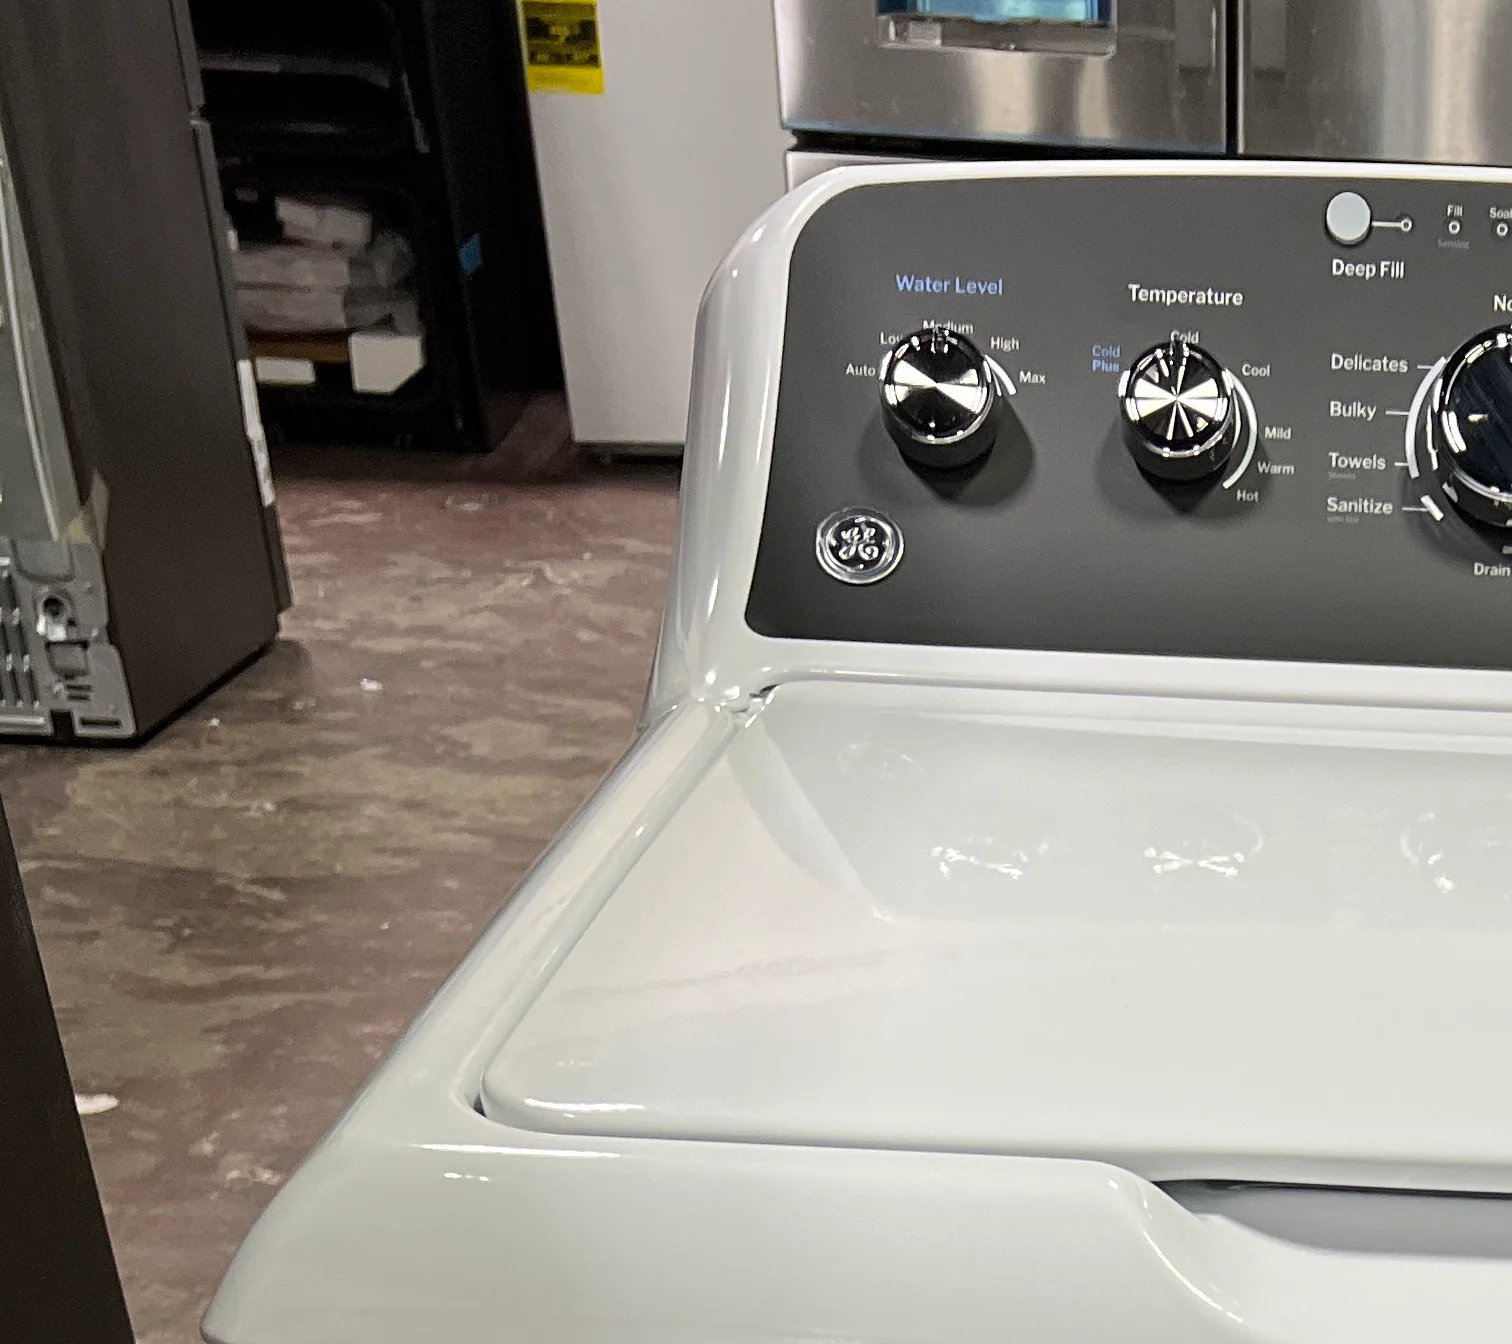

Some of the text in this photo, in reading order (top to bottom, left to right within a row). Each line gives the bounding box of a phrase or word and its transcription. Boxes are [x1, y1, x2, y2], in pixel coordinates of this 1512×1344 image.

[1446, 204, 1464, 218] Fill
[1331, 258, 1405, 281] Deep Fill
[895, 273, 1004, 296] Water Level
[1128, 283, 1244, 306] Temperature
[990, 336, 1020, 353] High
[1170, 329, 1200, 345] Cold
[1092, 344, 1121, 358] Cold
[845, 363, 877, 377] Auto
[1092, 358, 1120, 373] Plus
[1241, 363, 1271, 377] Cool
[1331, 353, 1409, 373] Delicates
[1019, 370, 1046, 385] Max
[1329, 400, 1377, 421] Bulky
[1264, 426, 1292, 440] Mild
[1257, 461, 1295, 475] Warm
[1328, 451, 1387, 470] Towels
[1236, 488, 1259, 503] Hot
[1326, 496, 1393, 515] Sanitize
[1473, 562, 1511, 577] Drain
